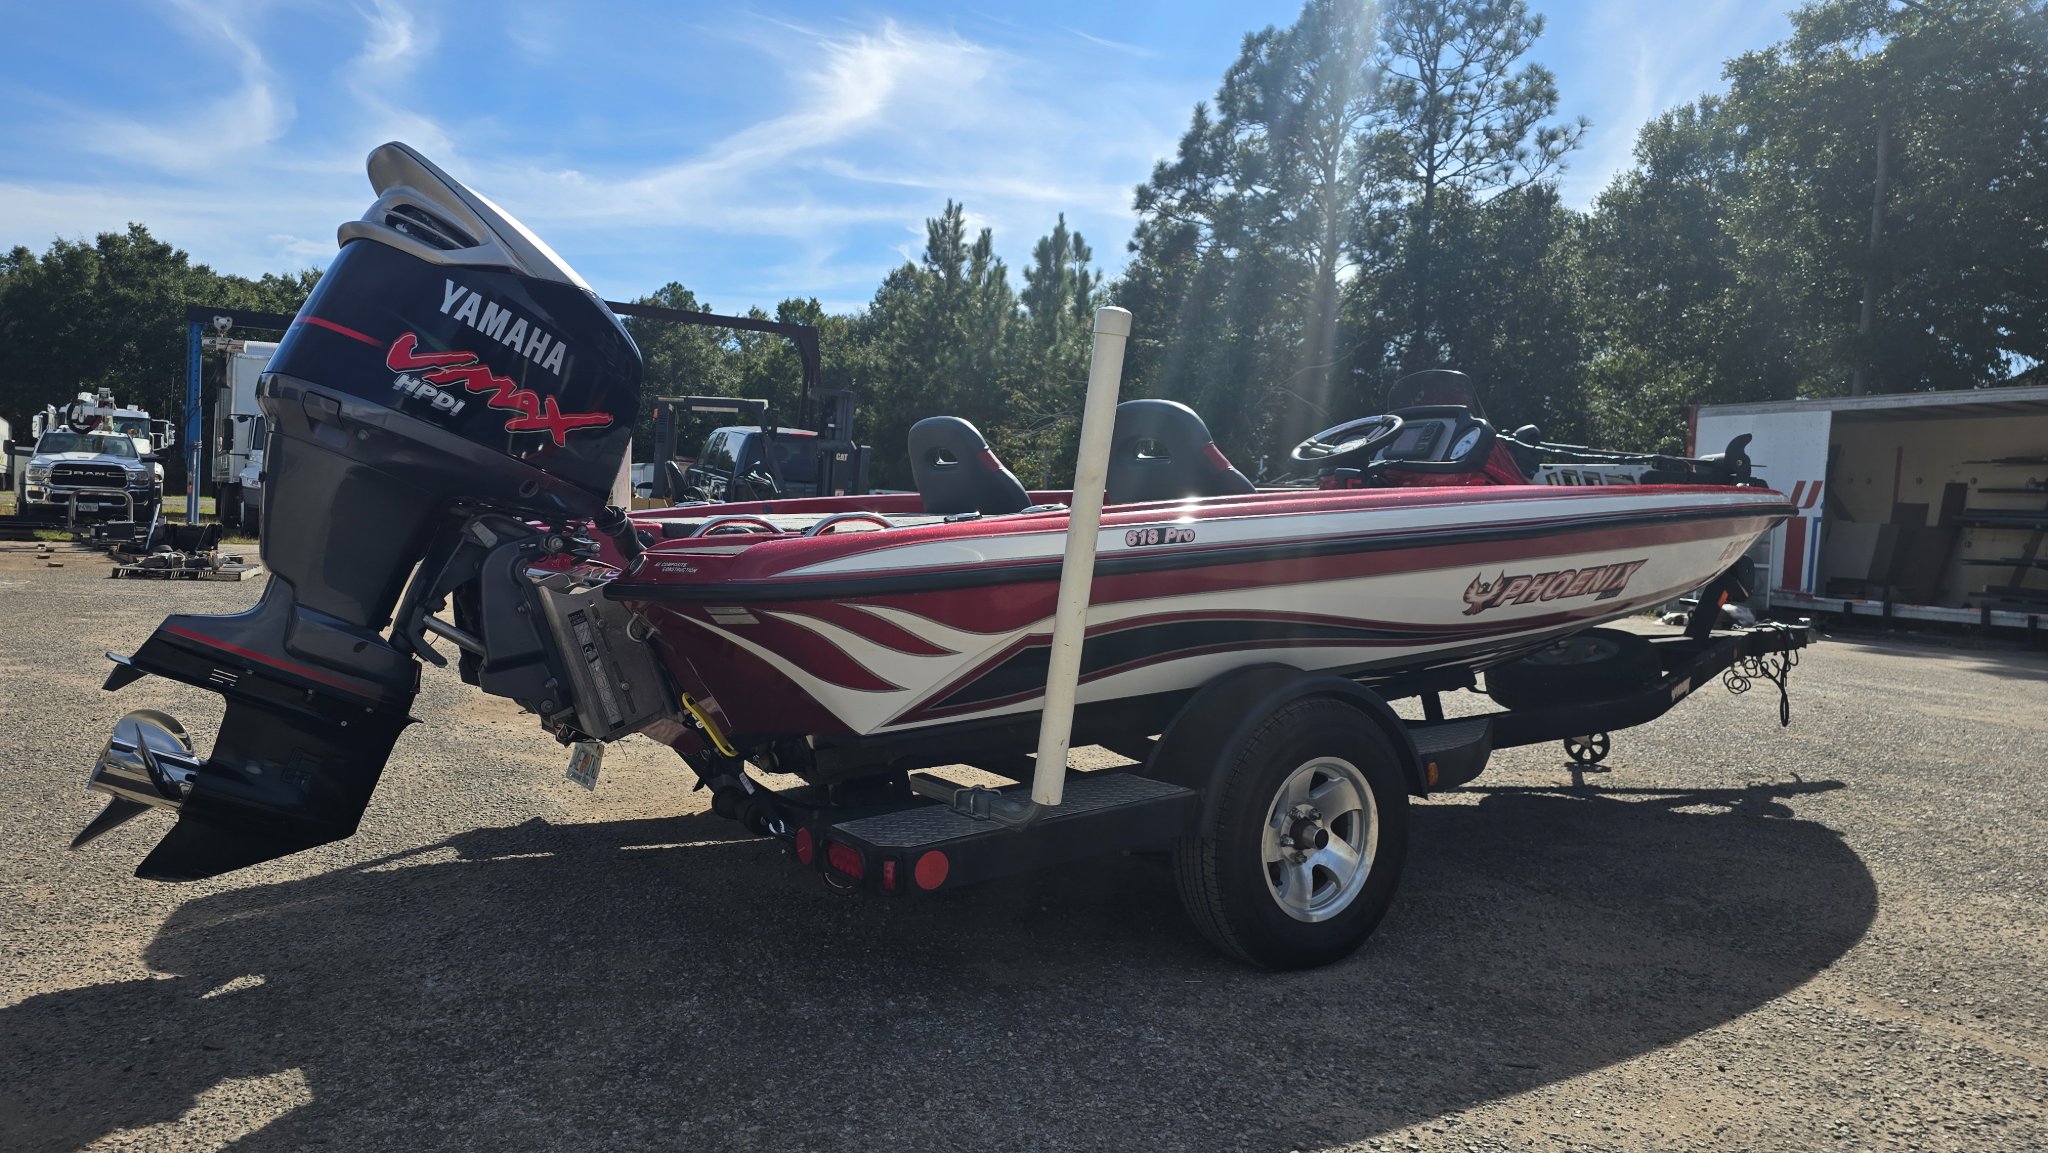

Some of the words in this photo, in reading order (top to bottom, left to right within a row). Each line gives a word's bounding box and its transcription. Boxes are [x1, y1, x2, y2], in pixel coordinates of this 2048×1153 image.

[439, 279, 567, 376] YAMAHA
[393, 373, 466, 417] HPDI
[836, 453, 848, 461] CAT
[1125, 528, 1159, 547] 618
[1163, 526, 1195, 544] Pro
[1494, 559, 1648, 607] PHOENIX
